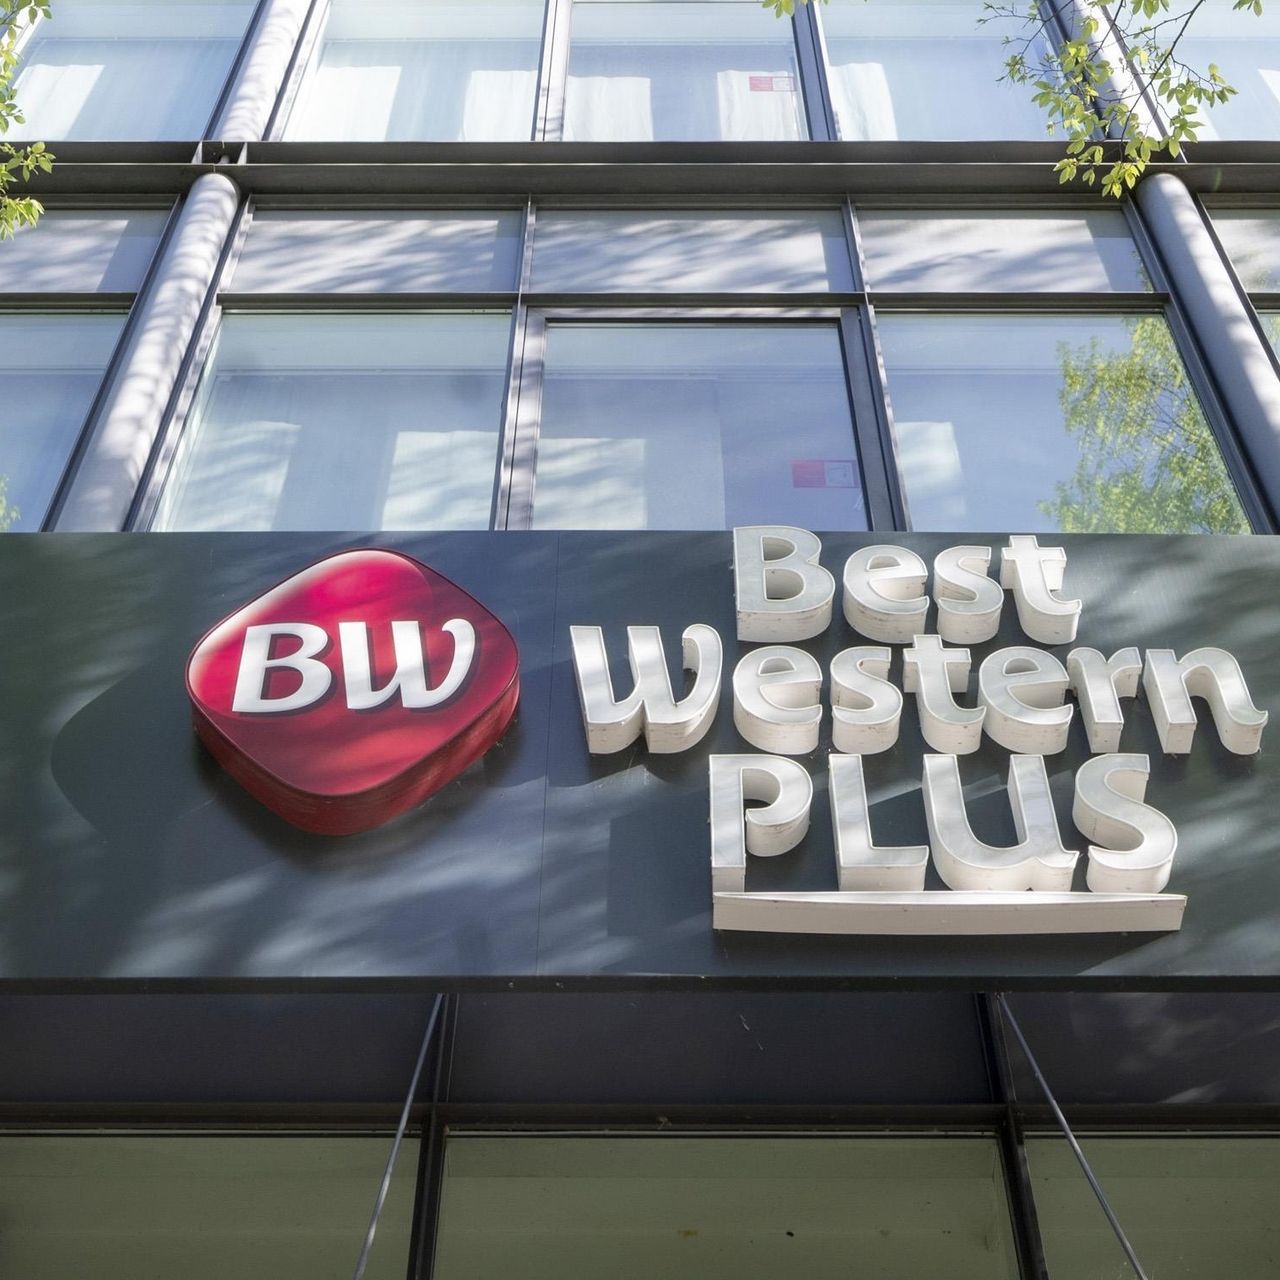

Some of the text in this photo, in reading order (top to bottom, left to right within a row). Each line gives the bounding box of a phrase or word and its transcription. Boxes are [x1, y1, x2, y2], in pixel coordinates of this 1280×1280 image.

[733, 525, 1082, 644] Best
[231, 618, 476, 713] BW
[570, 624, 1269, 754] Western
